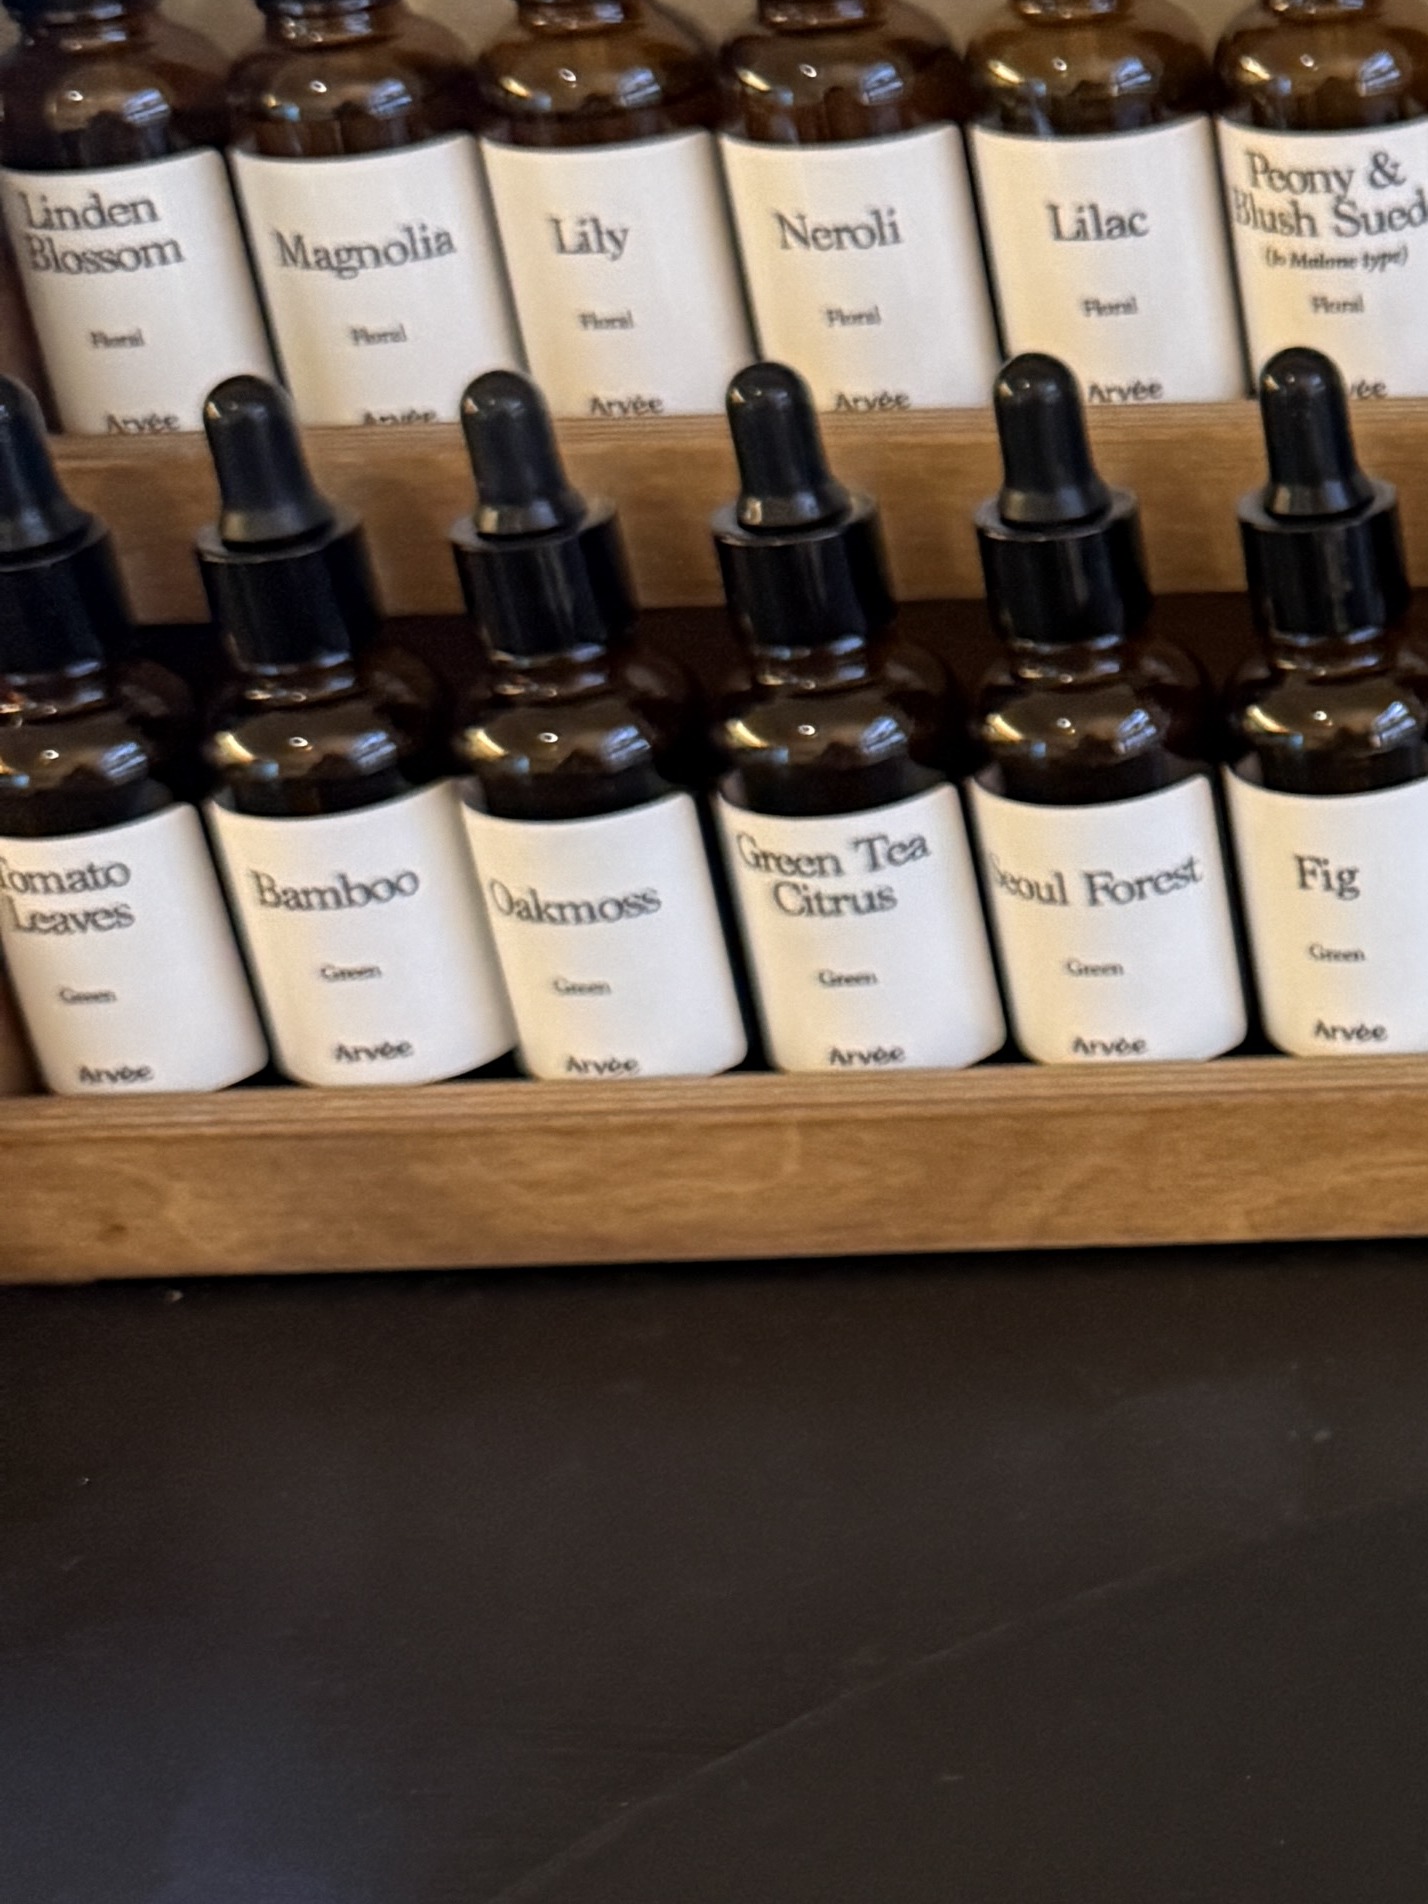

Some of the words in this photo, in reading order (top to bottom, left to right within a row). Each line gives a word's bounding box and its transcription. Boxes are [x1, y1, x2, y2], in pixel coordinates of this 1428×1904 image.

[1245, 151, 1354, 196] Peony
[1369, 151, 1406, 190] &
[20, 194, 158, 230] Linden
[1046, 202, 1150, 244] Lilac
[1233, 186, 1318, 237] Blush
[549, 215, 629, 261] Lily
[773, 206, 903, 252] Neroli
[28, 235, 184, 275] Blossom
[273, 222, 458, 280] Magnolia
[590, 392, 663, 417] Arvée
[834, 389, 909, 413] Arvée
[1088, 379, 1163, 404] Arvée
[105, 410, 181, 433] Arvée
[735, 832, 841, 878] Green
[853, 831, 930, 875] Tea
[1082, 855, 1203, 907] Forest
[1294, 855, 1360, 899] Fig
[250, 869, 419, 912] Bamboo
[489, 881, 661, 926] Oakmoss
[772, 882, 897, 918] Citrus
[7, 895, 136, 935] Leaves
[1309, 943, 1365, 964] Green
[320, 962, 381, 982] Green
[817, 968, 877, 987] Green
[1066, 958, 1124, 978] Green
[59, 986, 117, 1004] Green
[553, 977, 611, 996] Green
[1314, 1019, 1388, 1043] Arvée
[334, 1037, 414, 1063] Arvée
[828, 1043, 905, 1066] Arvée
[1072, 1035, 1148, 1057] Arvée
[79, 1064, 153, 1085] Arvée
[565, 1053, 641, 1077] Arvée
